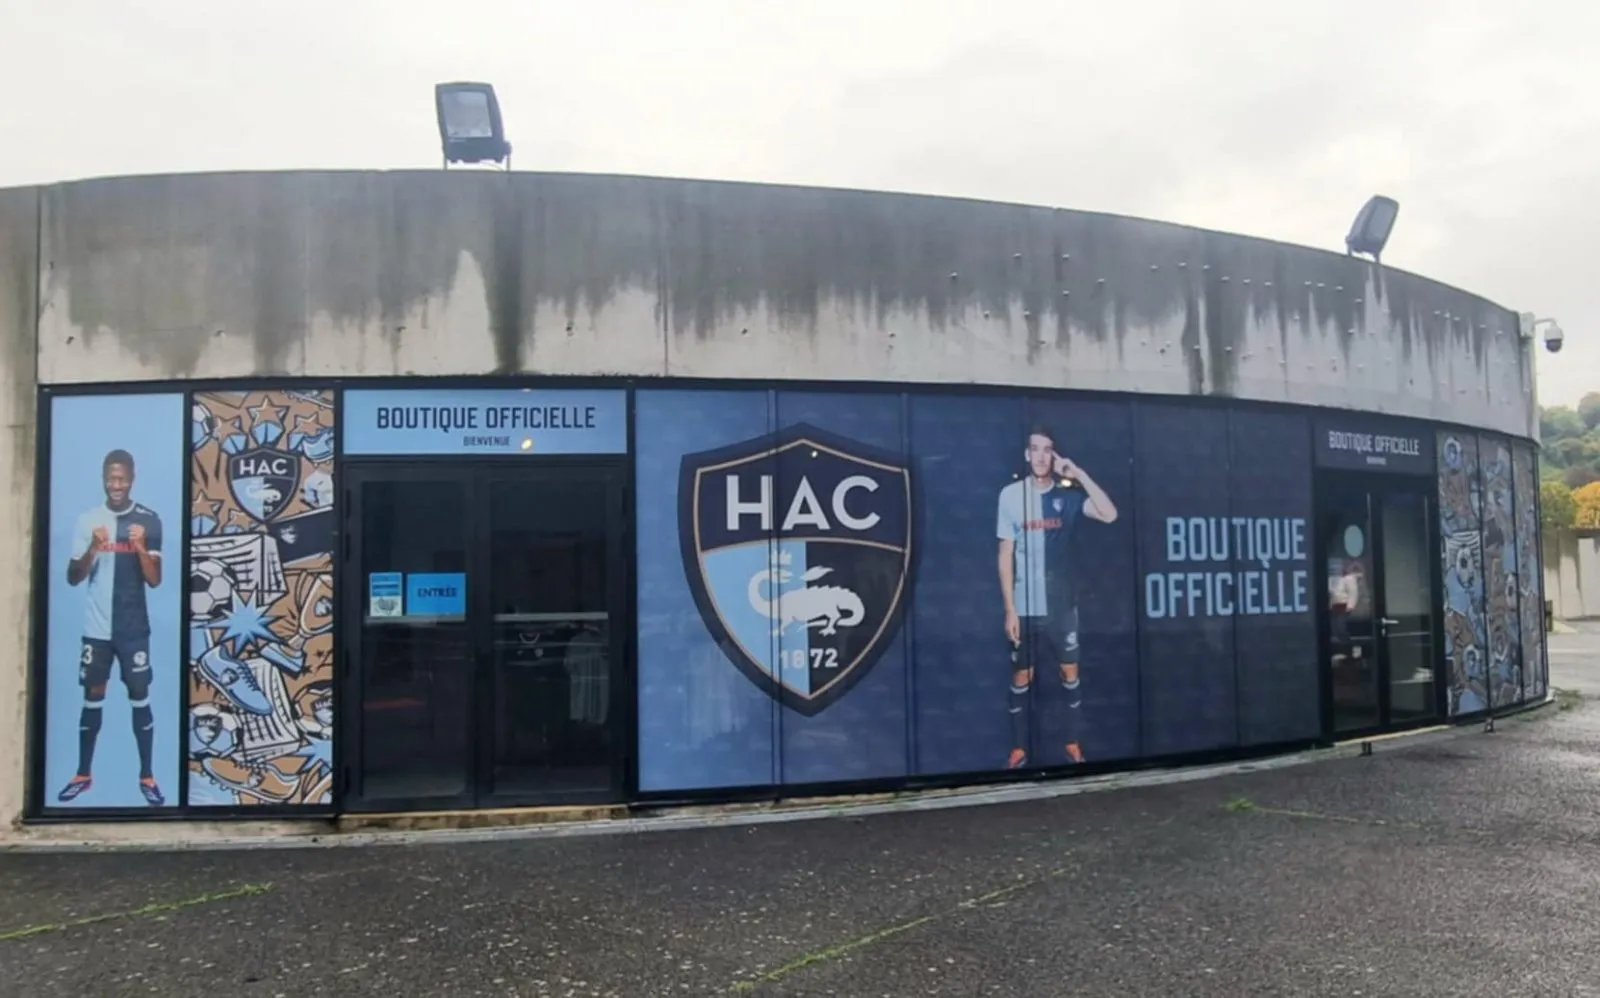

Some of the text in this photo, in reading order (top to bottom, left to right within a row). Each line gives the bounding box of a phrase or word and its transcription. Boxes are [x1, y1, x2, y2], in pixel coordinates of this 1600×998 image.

[377, 406, 596, 433] BOUTIQUE OFFICIELLE
[463, 436, 510, 446] BIENVENUE
[1328, 431, 1420, 455] BOUTIQUE OFFICIELLE
[240, 458, 288, 475] HAC
[725, 474, 881, 531] HAC
[1166, 516, 1306, 569] BOUTIQUE
[417, 584, 457, 598] ENTRÉE
[1145, 570, 1309, 618] OFFICIELLE
[780, 648, 839, 669] 1872
